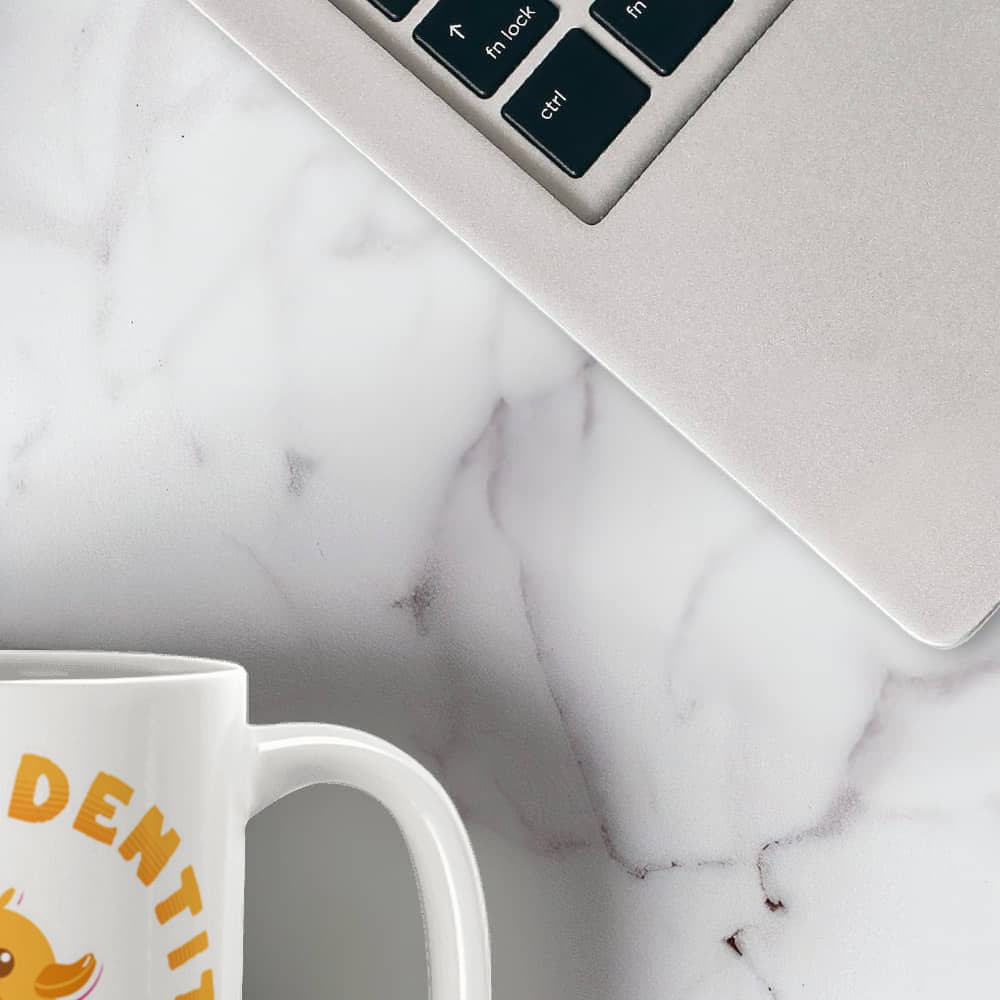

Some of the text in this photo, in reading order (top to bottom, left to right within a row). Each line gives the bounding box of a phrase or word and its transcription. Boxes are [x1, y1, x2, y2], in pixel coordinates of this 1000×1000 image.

[626, 0, 648, 19] fn
[486, 6, 537, 60] fn lock
[541, 89, 567, 120] ctrl
